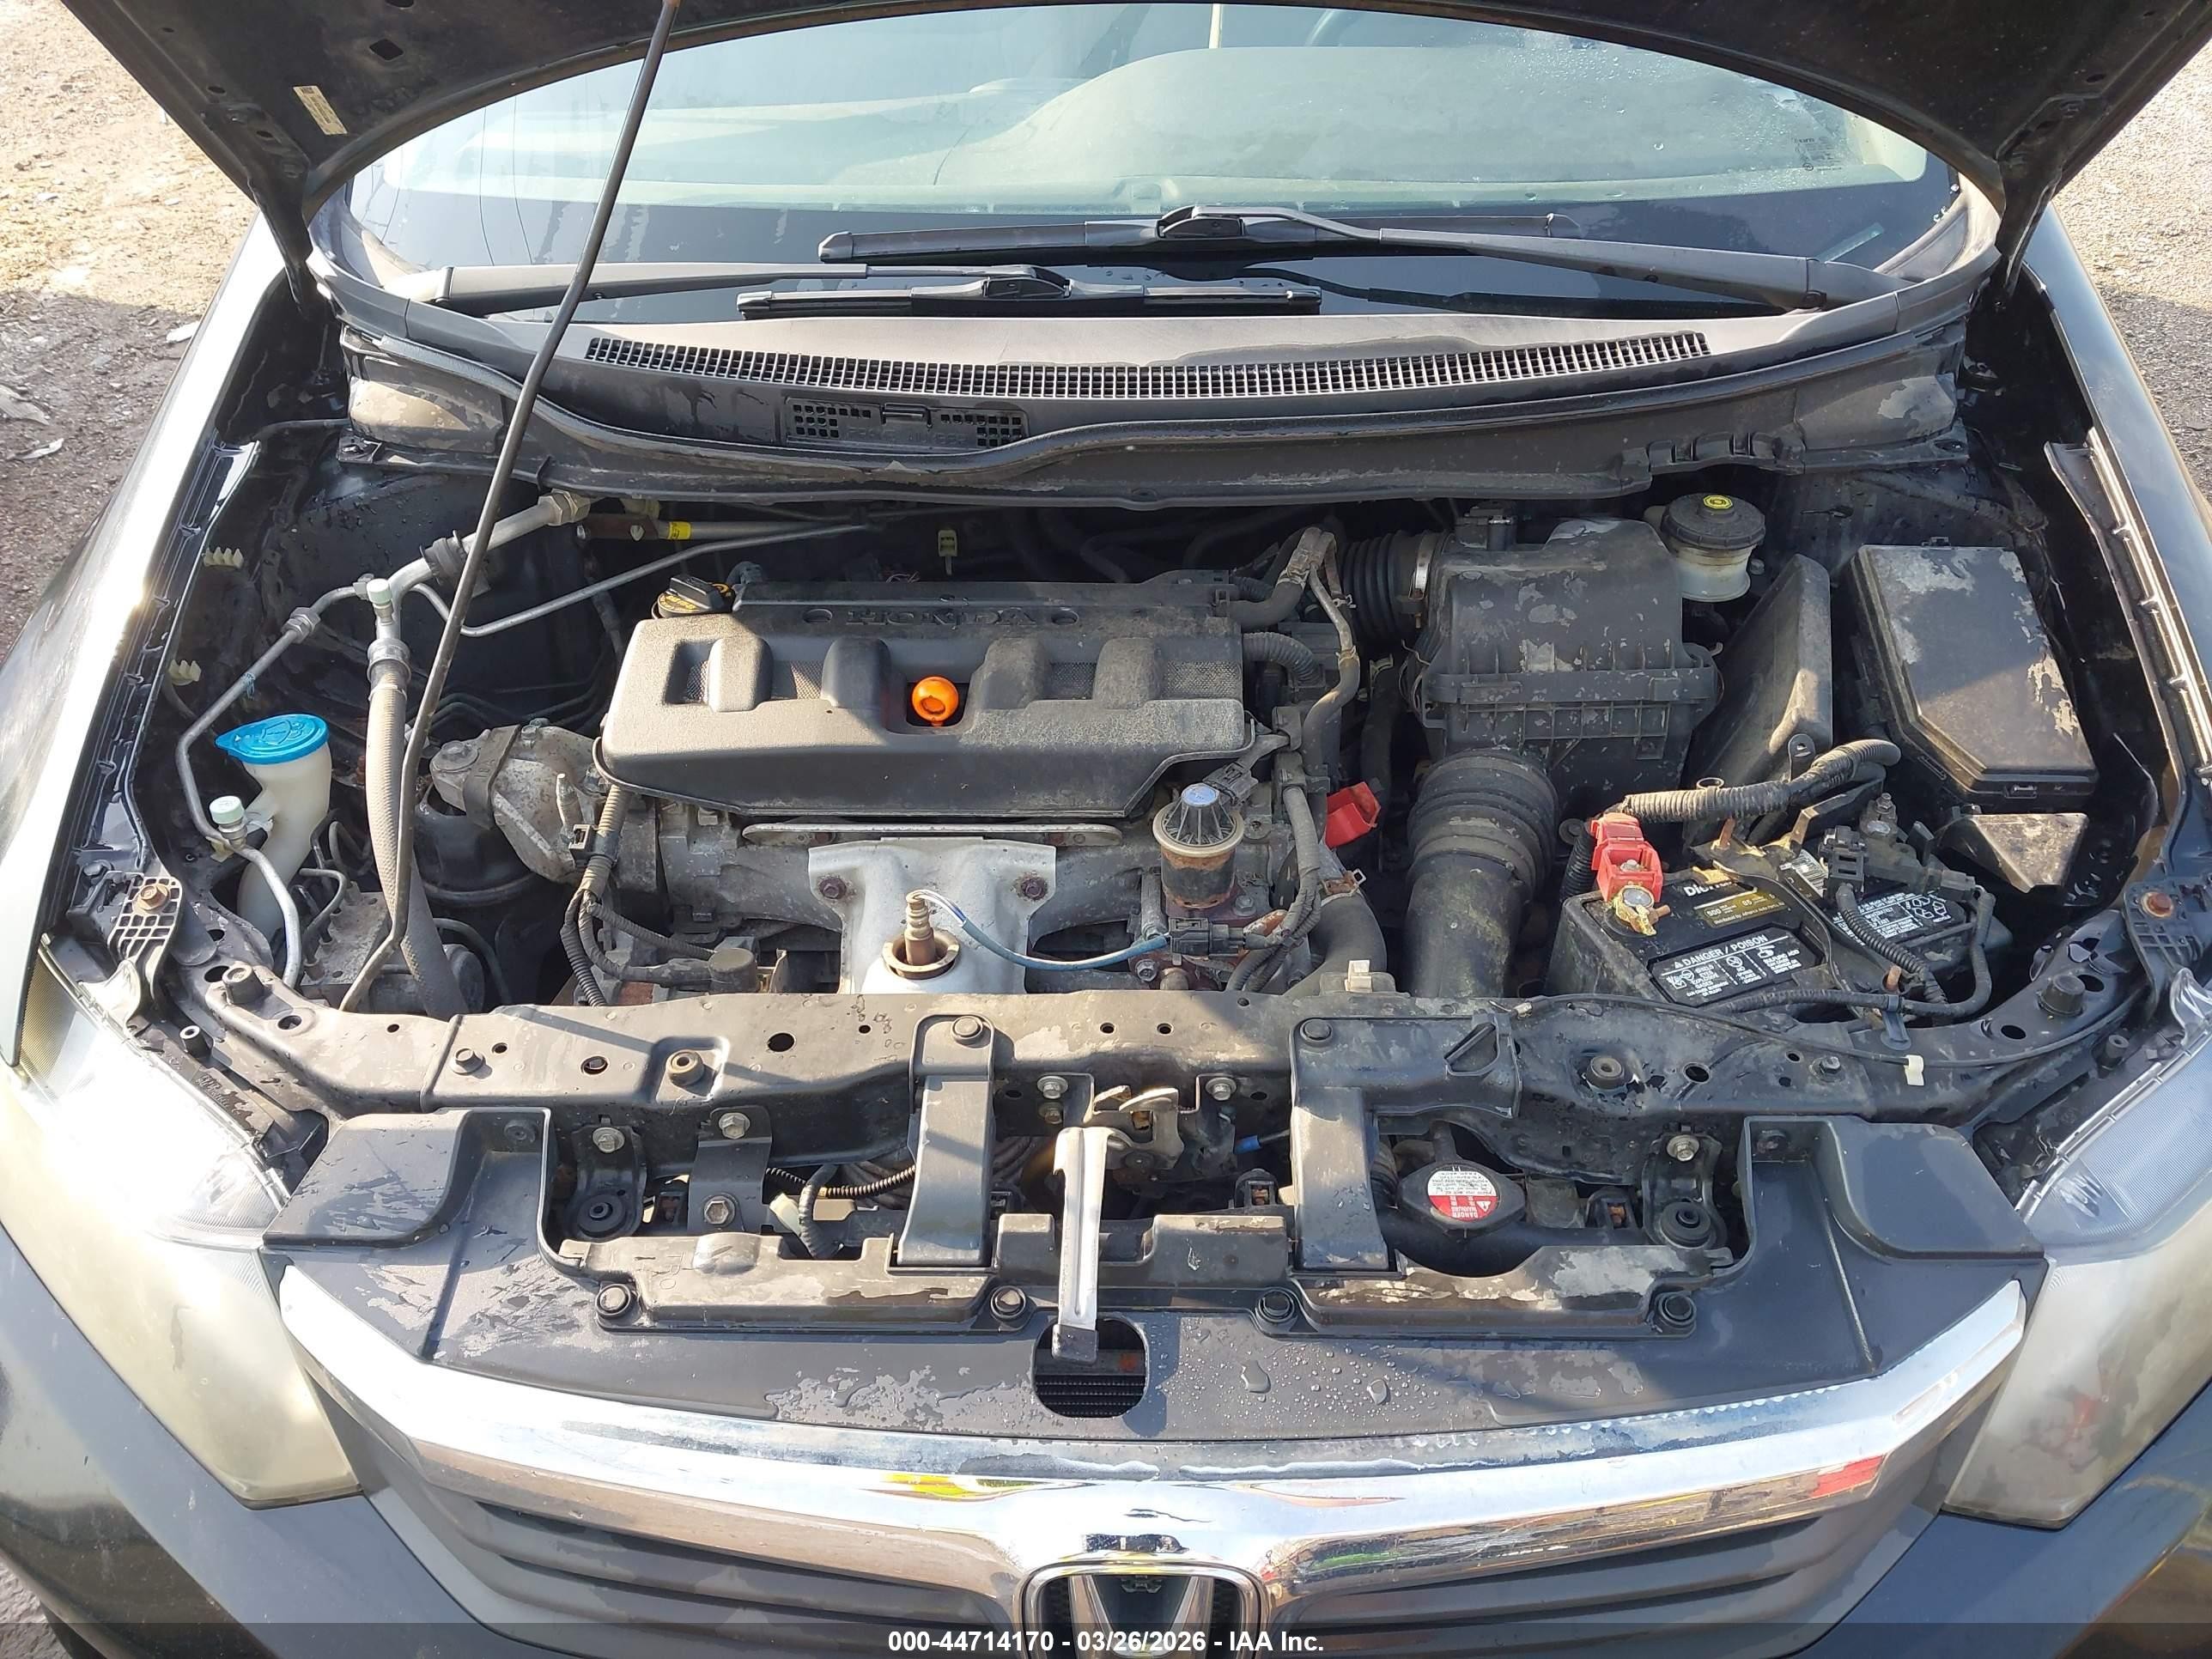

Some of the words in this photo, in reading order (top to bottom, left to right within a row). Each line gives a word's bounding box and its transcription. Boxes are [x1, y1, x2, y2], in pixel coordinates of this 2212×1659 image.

[845, 606, 1036, 626] HONDA
[1682, 948, 1724, 966] DANGER
[1732, 934, 1769, 951] POISON
